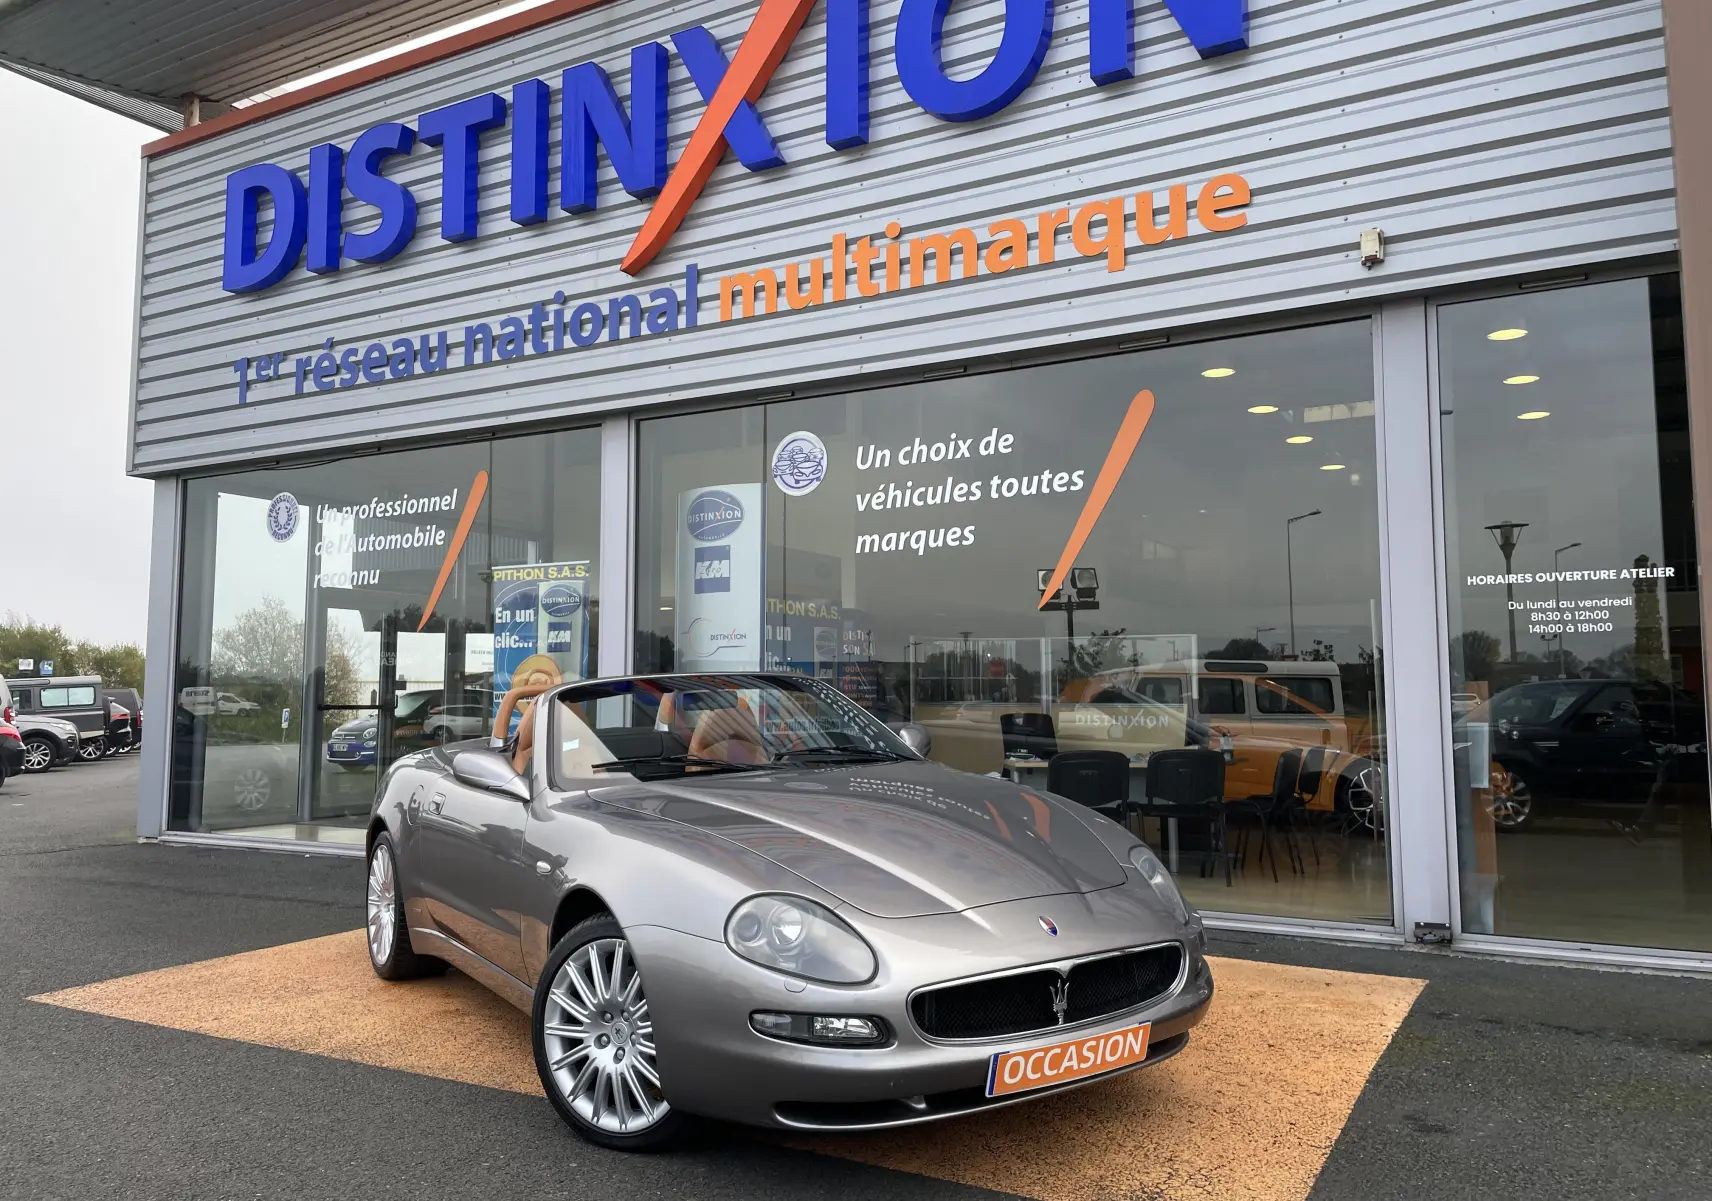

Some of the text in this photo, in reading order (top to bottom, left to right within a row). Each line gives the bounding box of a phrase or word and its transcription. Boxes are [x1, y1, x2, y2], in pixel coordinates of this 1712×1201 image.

[233, 172, 1251, 404] 1er réseau national multimarque
[856, 427, 1015, 470] Un choix de
[856, 469, 1085, 512] véhicules toutes
[316, 488, 458, 526] Un professionnel
[687, 506, 742, 523] DISTINXION
[314, 524, 446, 556] de l'Automobile
[855, 525, 976, 556] marques
[313, 569, 380, 589] reconnu
[493, 565, 589, 582] PITHON S.A.S.
[1467, 566, 1675, 586] HORAIRES OUVERTURE ATELIER
[1508, 597, 1633, 610] Du lundi au vendredi
[495, 607, 535, 623] En un
[1531, 609, 1610, 621] 8h30 à 12h00
[1528, 622, 1613, 634] 14h00 à 18h00
[495, 632, 533, 649] clic...
[1075, 710, 1169, 729] DISTINXION
[1003, 1029, 1144, 1085] OCCASION
